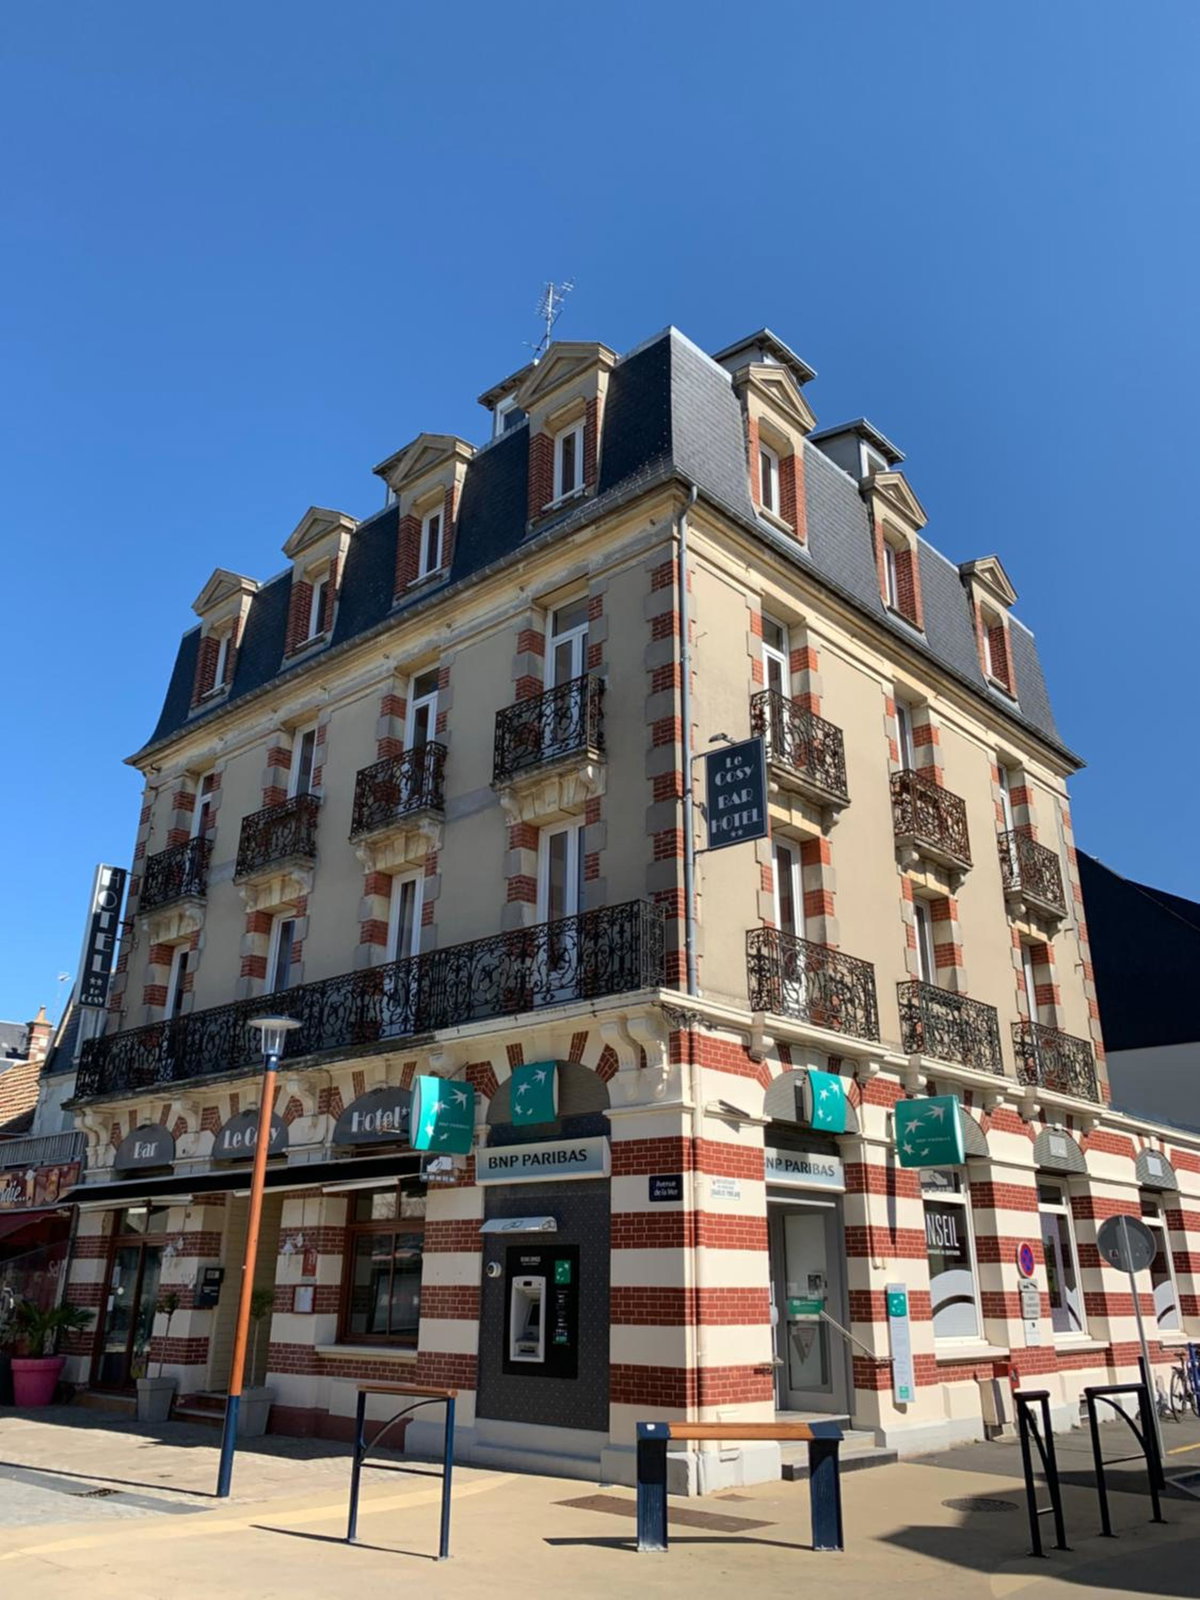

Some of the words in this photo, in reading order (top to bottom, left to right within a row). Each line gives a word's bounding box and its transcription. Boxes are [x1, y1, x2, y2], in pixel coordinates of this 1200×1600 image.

[725, 756, 743, 769] Le
[718, 788, 753, 809] BAR
[711, 808, 762, 833] HOTEL
[91, 868, 120, 974] HOTEL
[223, 1129, 242, 1149] Le
[244, 1125, 281, 1147] Cy
[133, 1140, 159, 1159] Bar
[488, 1154, 519, 1169] BNP
[522, 1148, 588, 1167] PARIBAS
[784, 1159, 836, 1177] PARIBAS
